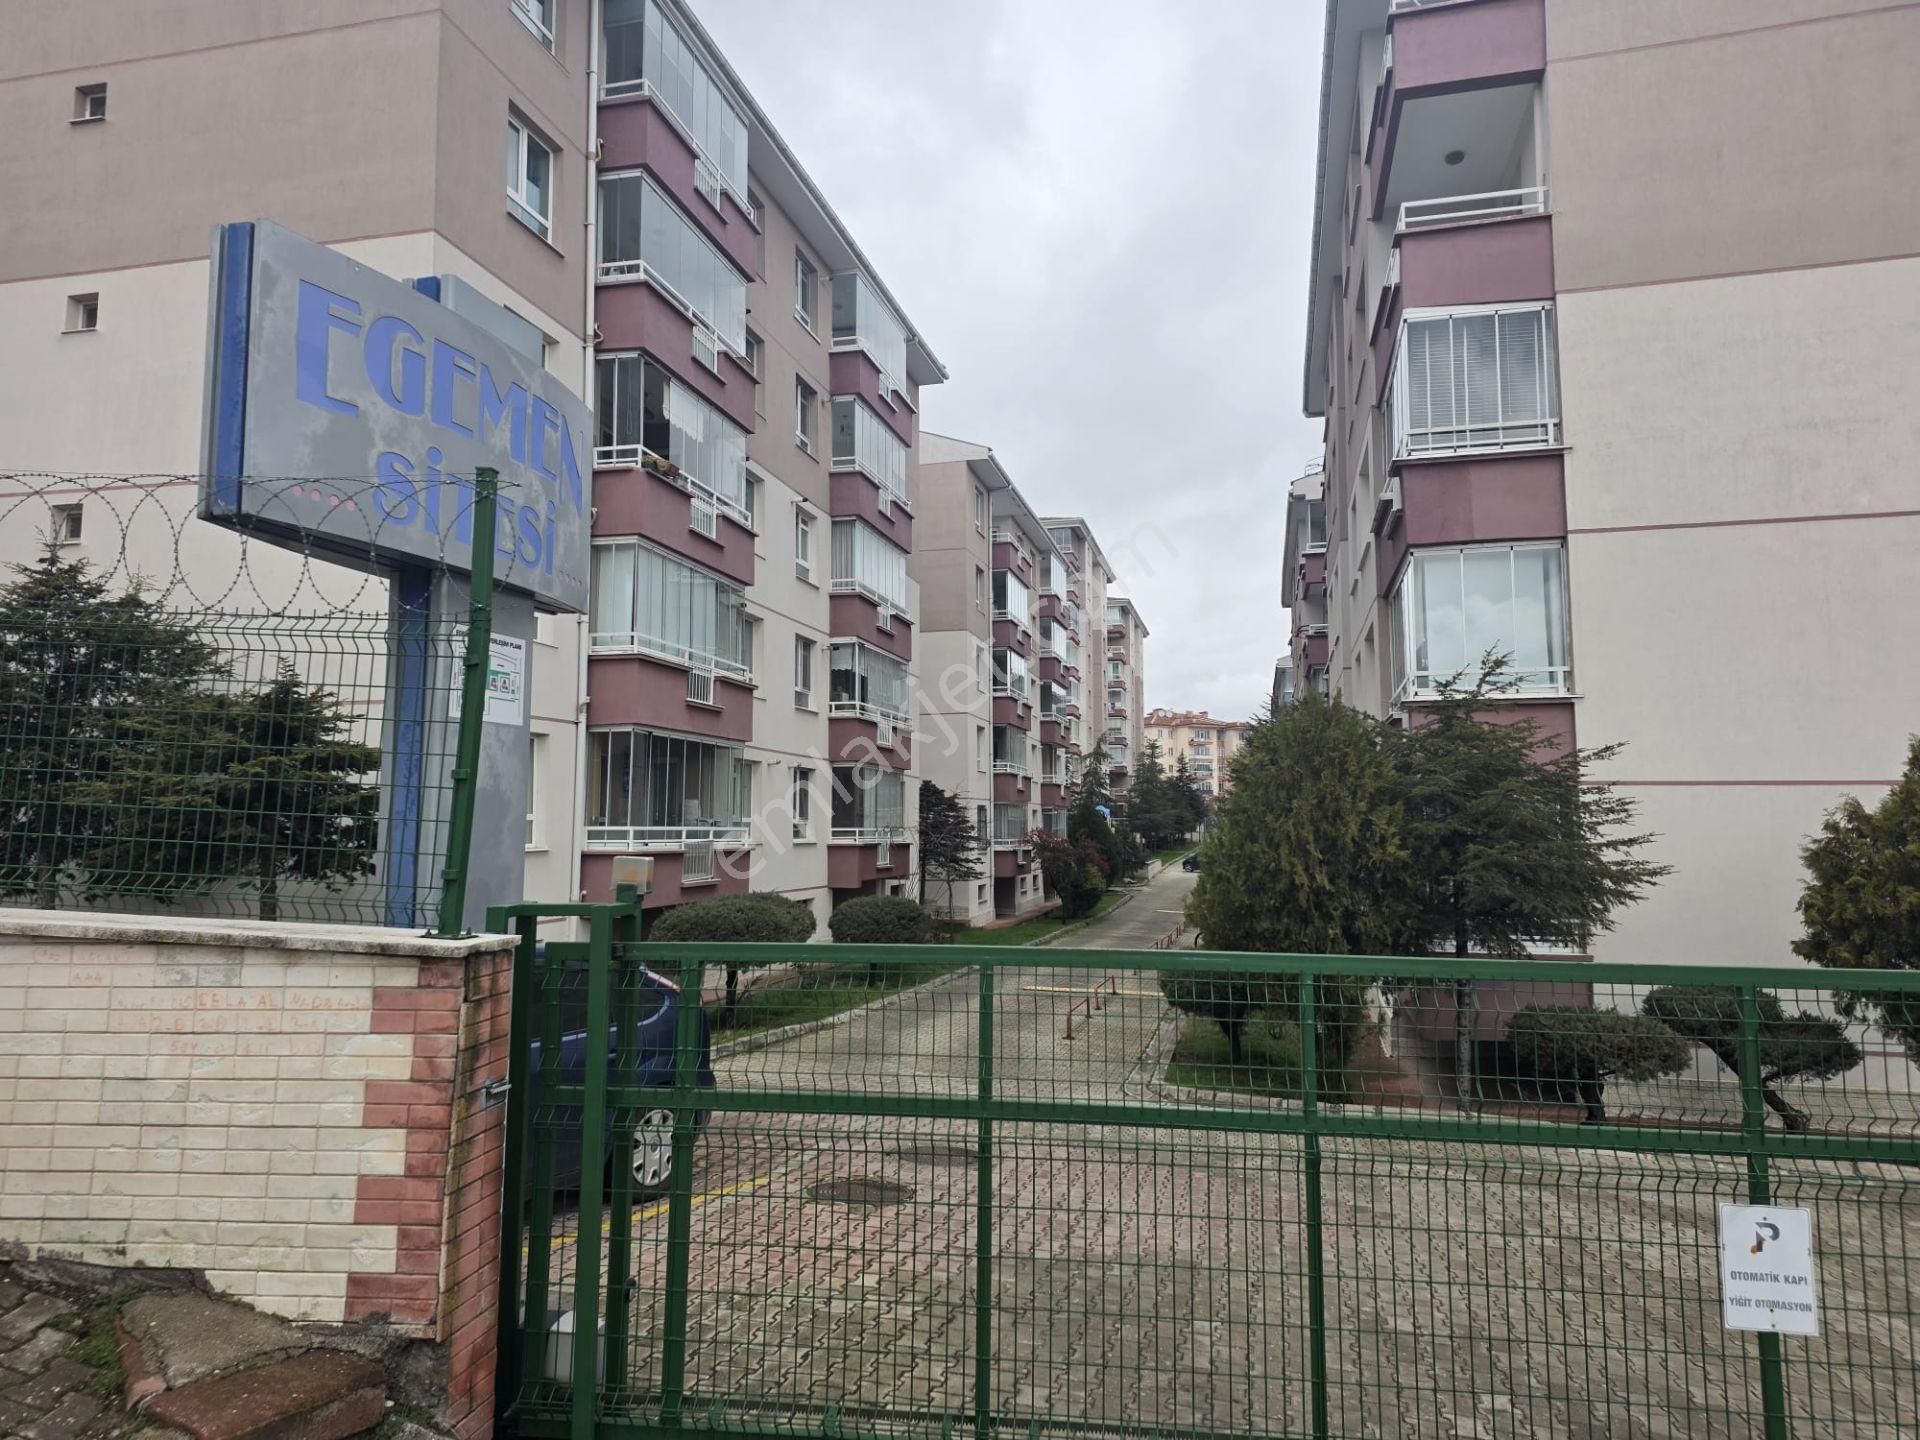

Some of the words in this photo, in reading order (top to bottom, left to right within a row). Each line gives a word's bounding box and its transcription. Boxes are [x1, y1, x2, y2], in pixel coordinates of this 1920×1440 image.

[296, 279, 583, 516] EGEMEN
[1730, 1270, 1780, 1284] OTOMATİK
[1784, 1275, 1808, 1286] KAPI
[1729, 1294, 1752, 1307] YİĞİT
[1755, 1298, 1812, 1313] OTOMASYON
